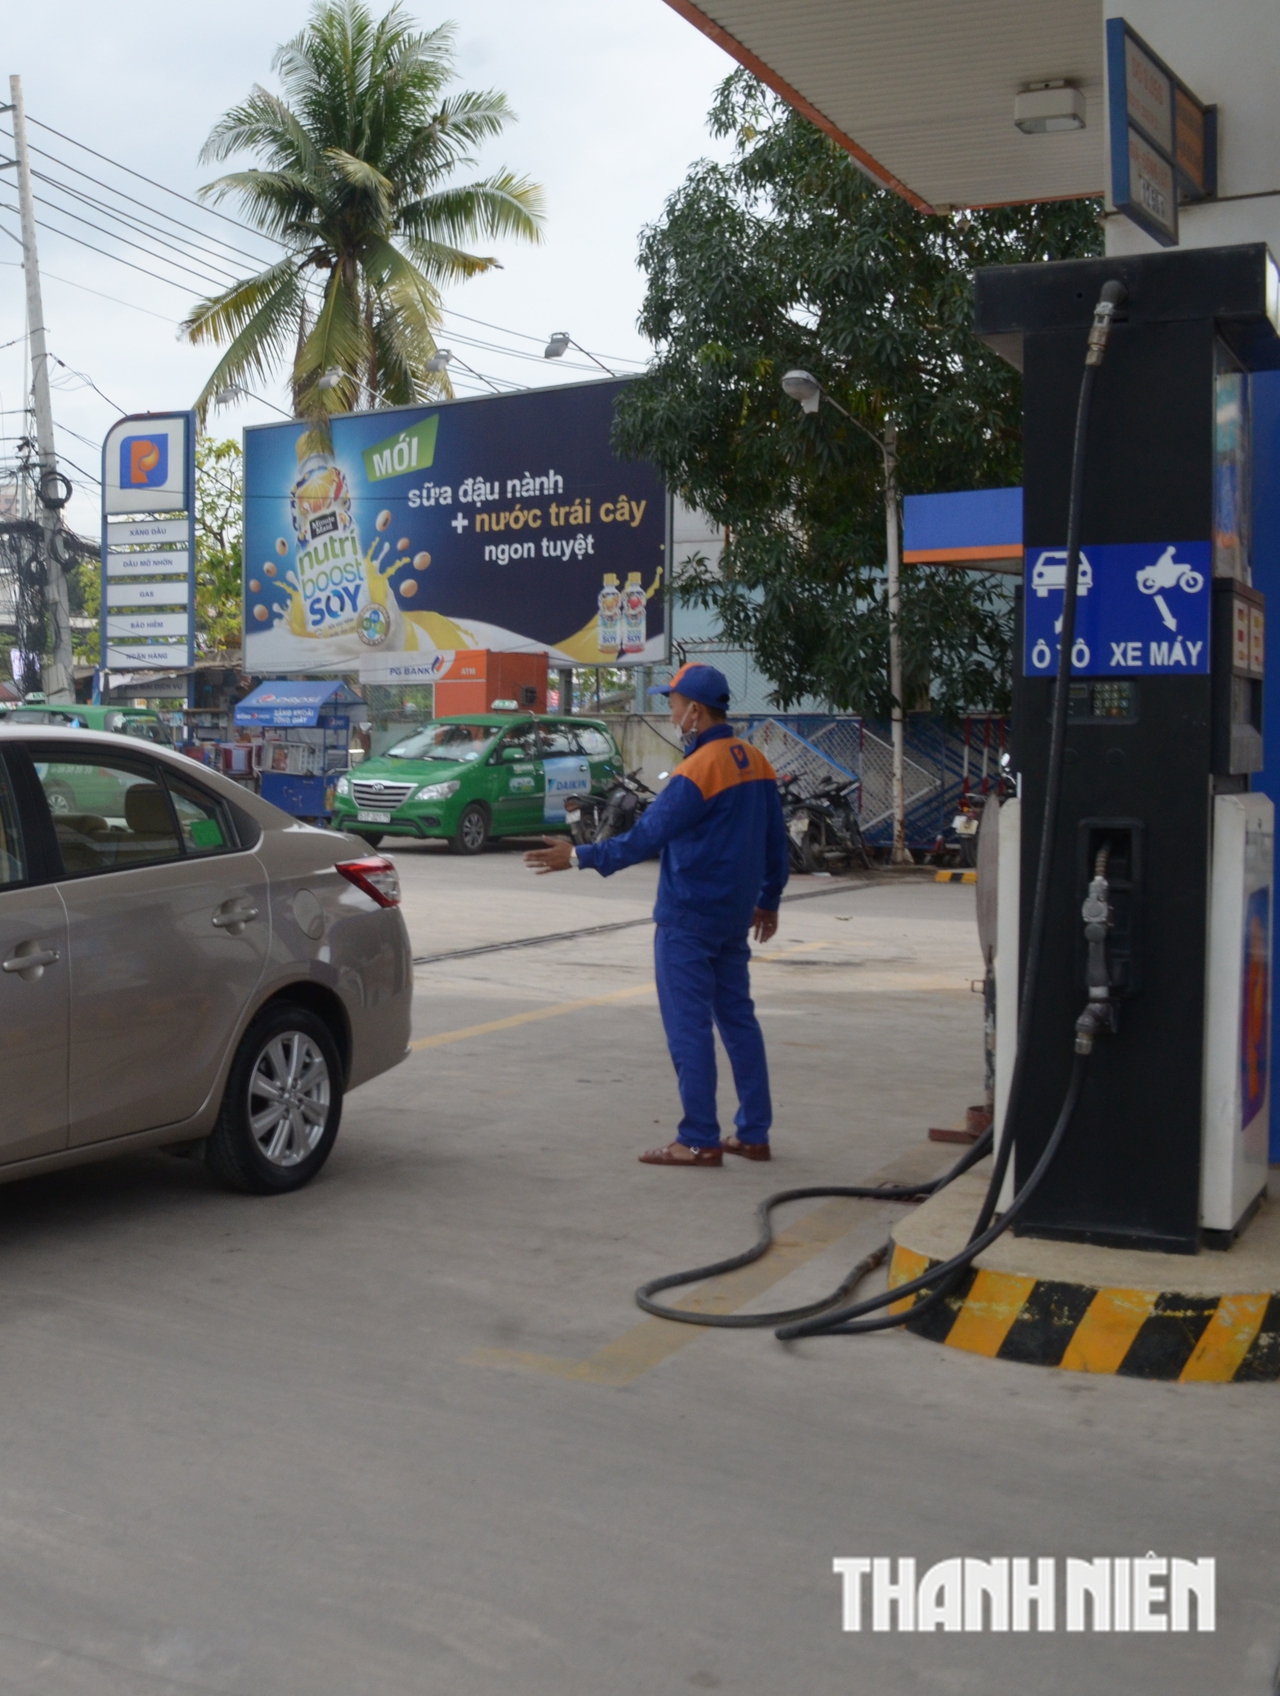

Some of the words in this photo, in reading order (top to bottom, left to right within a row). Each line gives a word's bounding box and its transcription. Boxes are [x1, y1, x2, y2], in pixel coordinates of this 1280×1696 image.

[372, 433, 419, 478] MỚI
[408, 482, 452, 508] sữa
[458, 476, 500, 507] đậu
[507, 469, 564, 499] nành
[475, 504, 542, 533] nước
[550, 498, 591, 527] trái
[599, 495, 646, 528] cây
[298, 529, 359, 577] nutri
[484, 541, 535, 565] ngon
[541, 534, 594, 561] tuyệt
[139, 590, 154, 598] GAS
[300, 557, 365, 601] boost
[309, 583, 362, 627] SOY
[1032, 639, 1051, 668] Ô
[1056, 638, 1091, 668] Ô
[1110, 641, 1143, 666] XE
[1150, 636, 1203, 666] MÁY
[404, 667, 431, 676] BANK
[461, 667, 476, 675] ATM
[556, 778, 588, 791] DAIKIN
